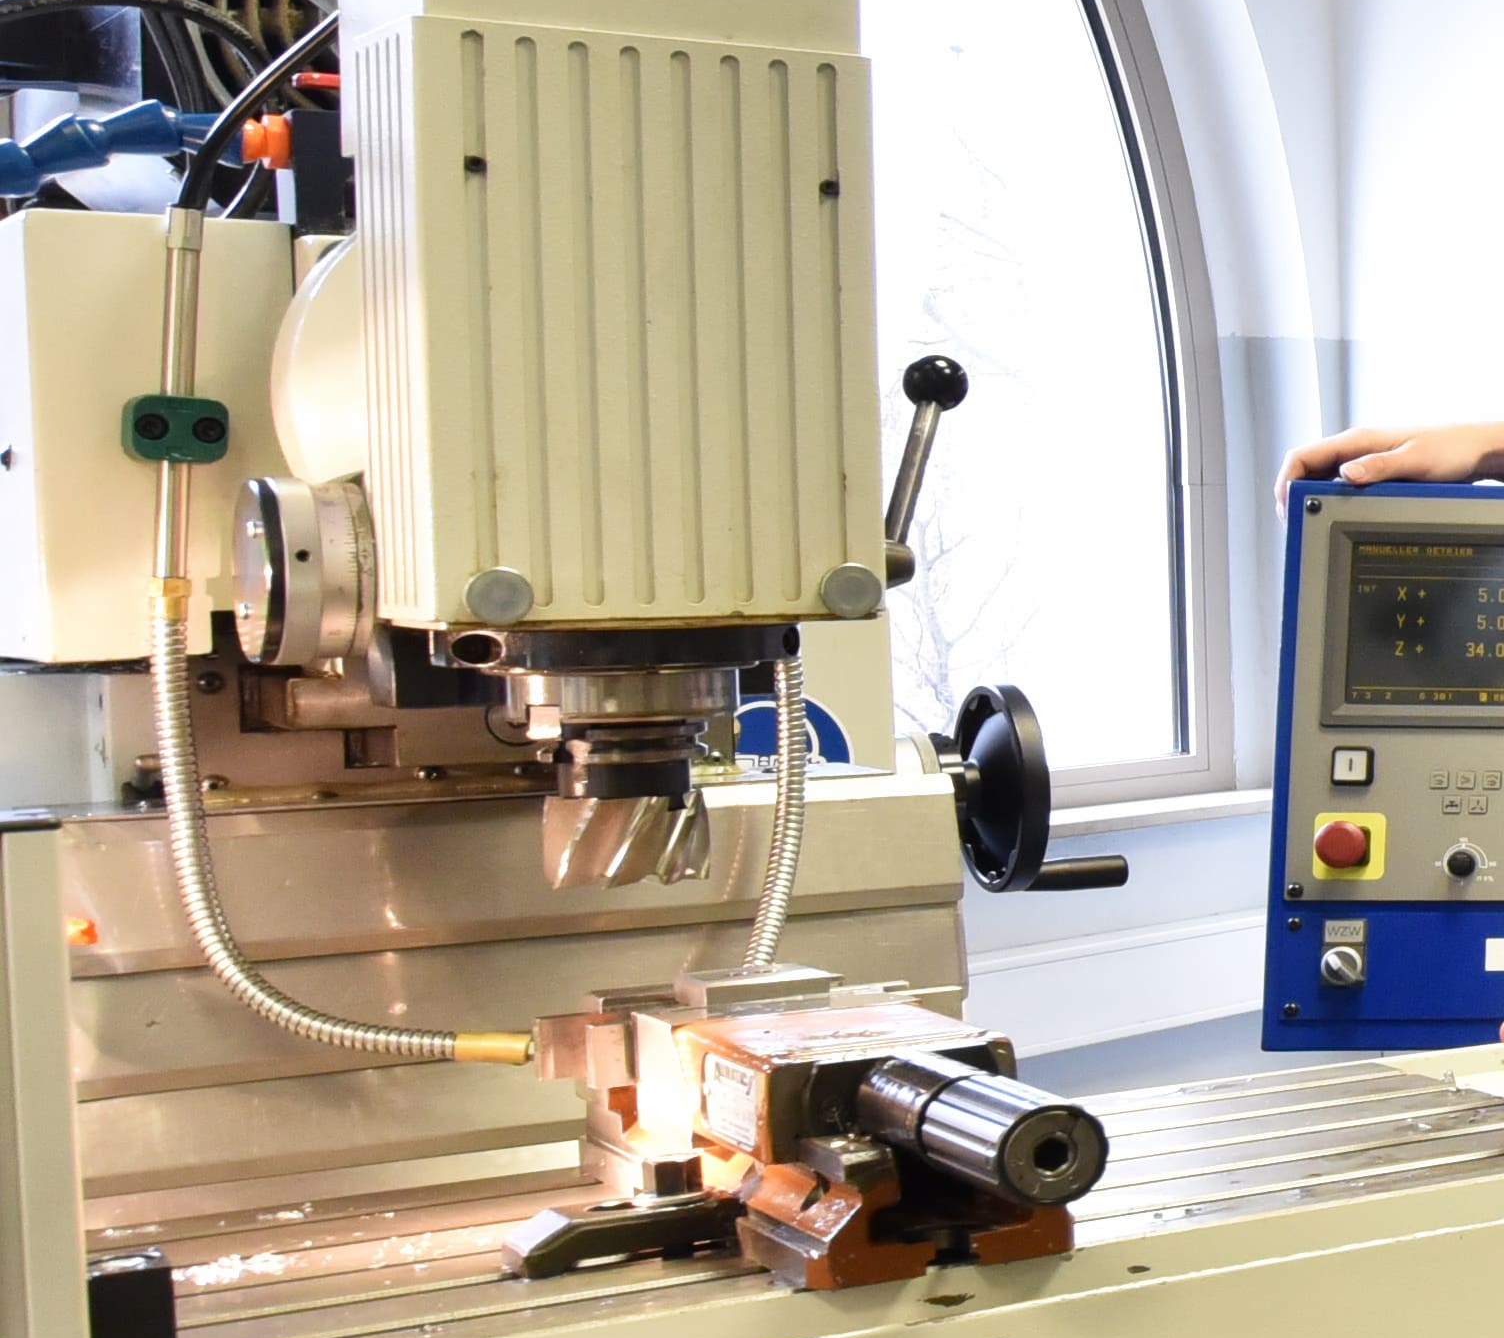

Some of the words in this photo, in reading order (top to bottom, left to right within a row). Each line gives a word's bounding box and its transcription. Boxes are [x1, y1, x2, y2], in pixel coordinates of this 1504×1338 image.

[1397, 586, 1408, 601] X
[1396, 613, 1406, 629] Y
[1394, 641, 1405, 656] Z
[1327, 925, 1362, 937] WZW
